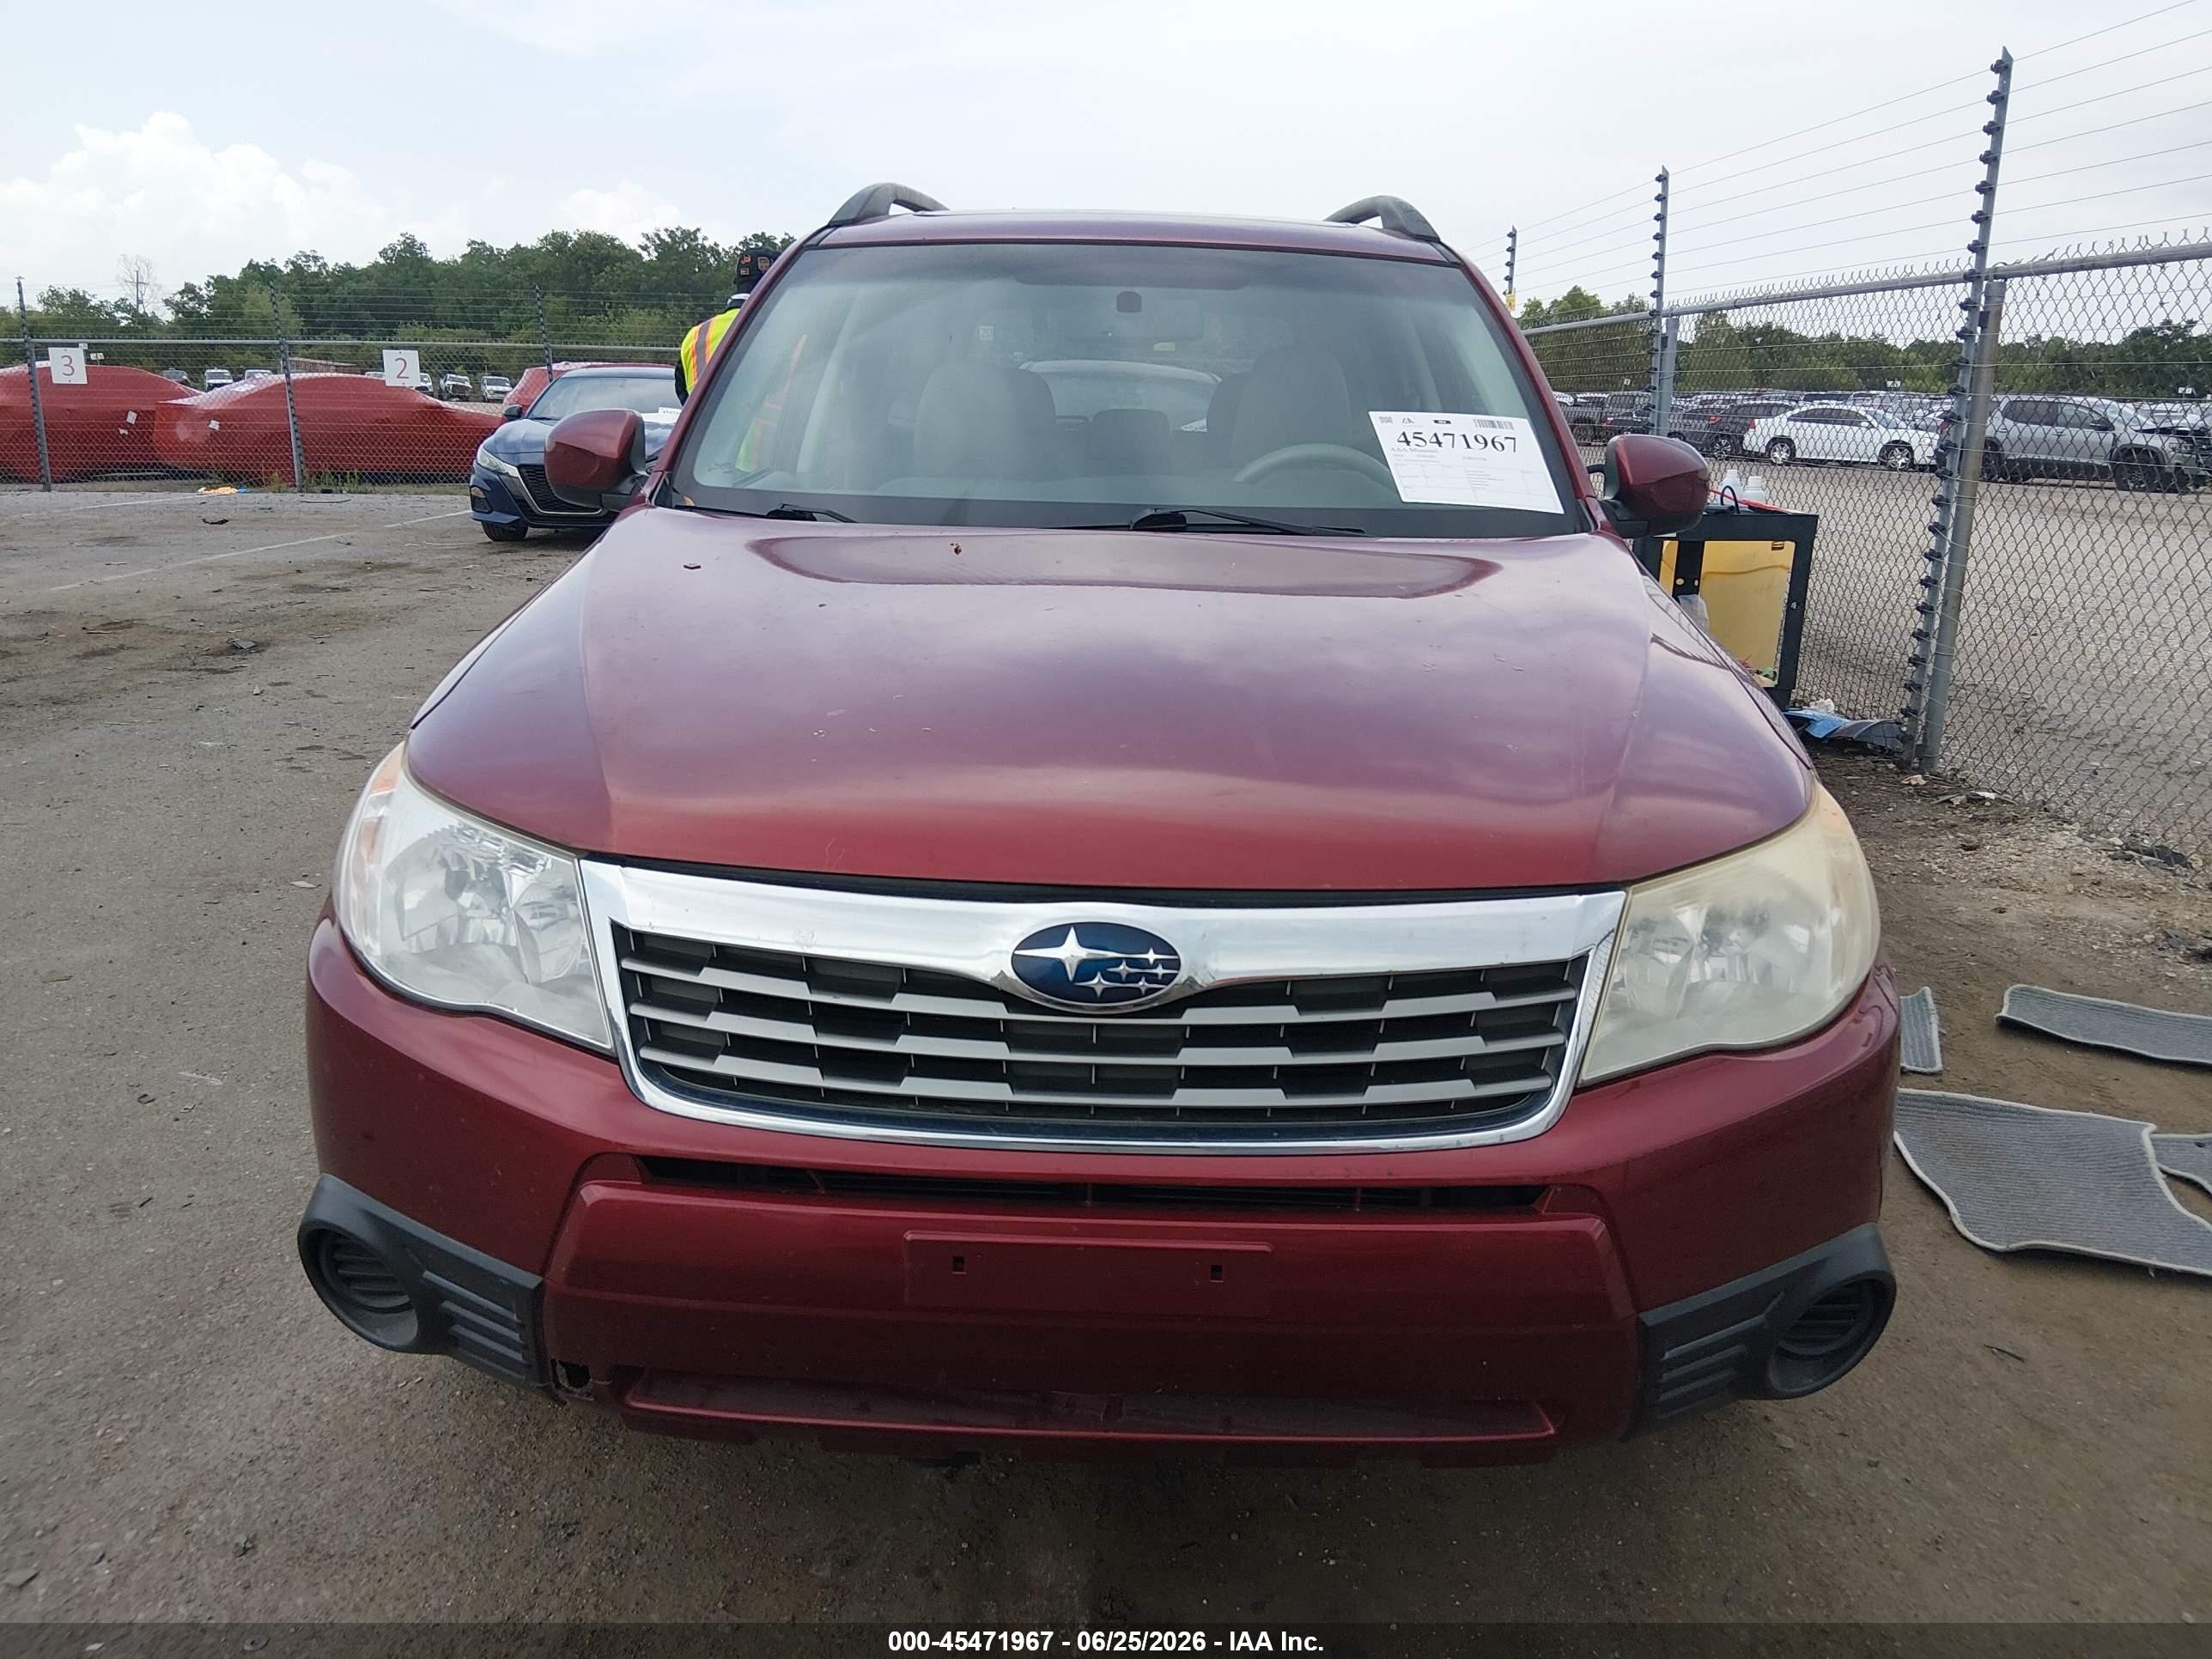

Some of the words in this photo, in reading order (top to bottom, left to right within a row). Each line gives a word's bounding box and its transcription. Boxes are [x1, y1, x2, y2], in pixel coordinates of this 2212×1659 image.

[61, 355, 76, 377] 3
[394, 357, 410, 380] 2
[1397, 430, 1517, 453] 45471967
